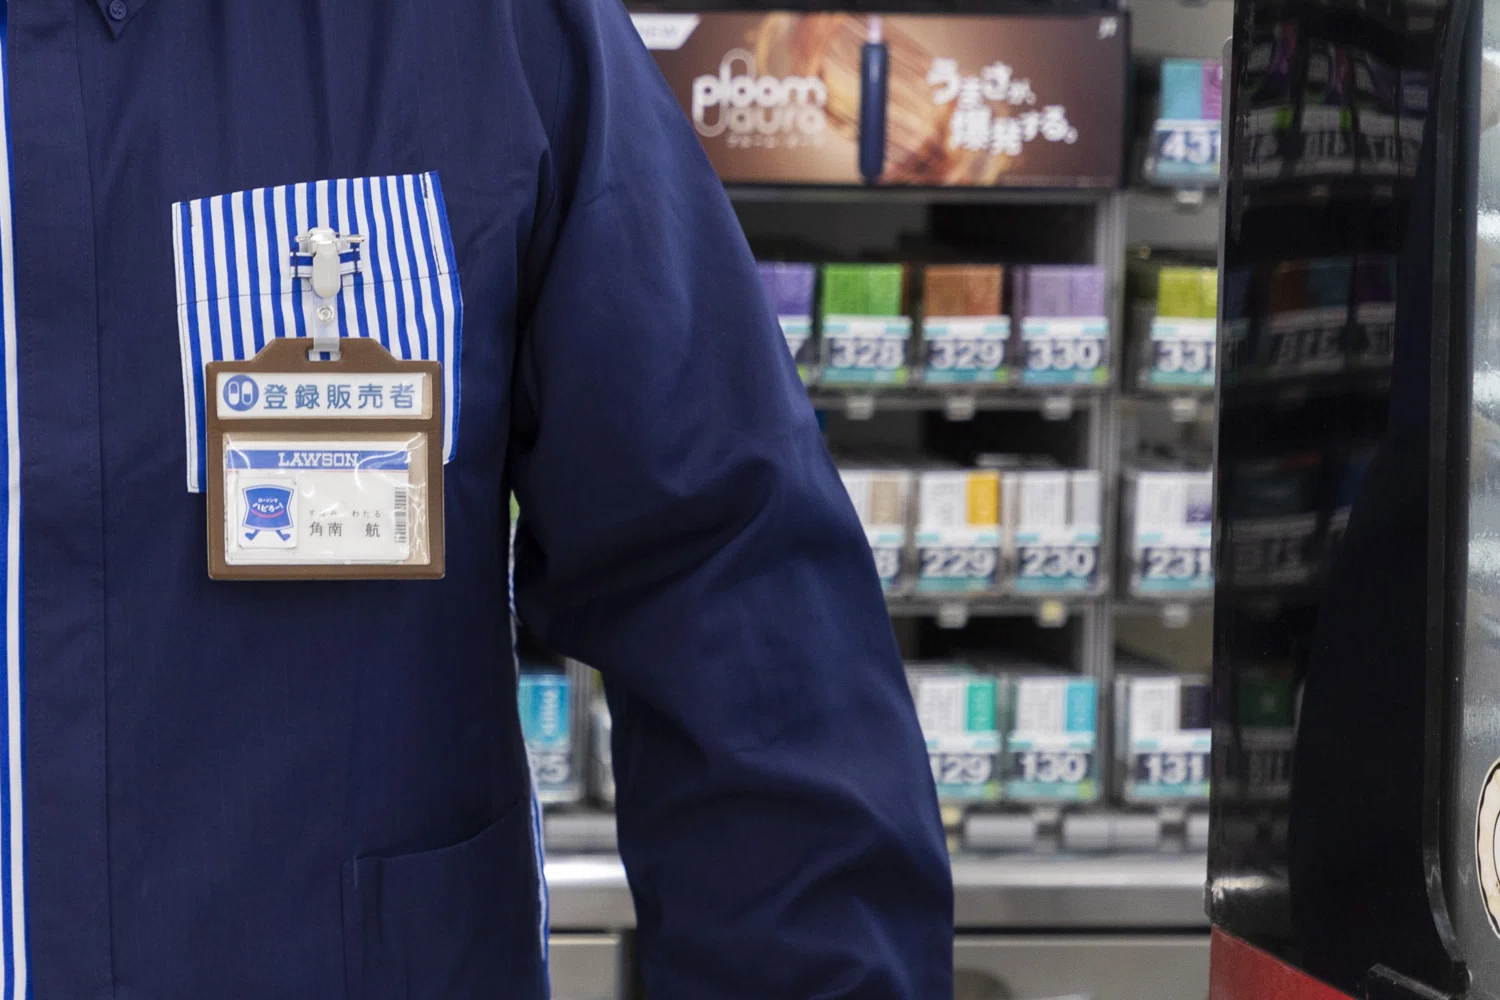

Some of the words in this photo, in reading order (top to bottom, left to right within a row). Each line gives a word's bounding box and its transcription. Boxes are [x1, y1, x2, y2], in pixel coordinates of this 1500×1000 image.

[693, 49, 827, 137] ploom
[729, 106, 827, 135] aura
[950, 104, 1078, 156] 爆発する。
[831, 337, 906, 369] 328
[932, 339, 1005, 370] 329
[1029, 340, 1101, 370] 330
[263, 383, 416, 411] 登録販売者
[278, 452, 360, 468] LAWSON
[352, 509, 382, 518] わたる
[309, 521, 343, 538] 角南
[365, 521, 381, 538] 航
[924, 547, 997, 578] 229
[1024, 547, 1094, 577] 230
[1022, 752, 1087, 783] 130
[1146, 752, 1211, 784] 131
